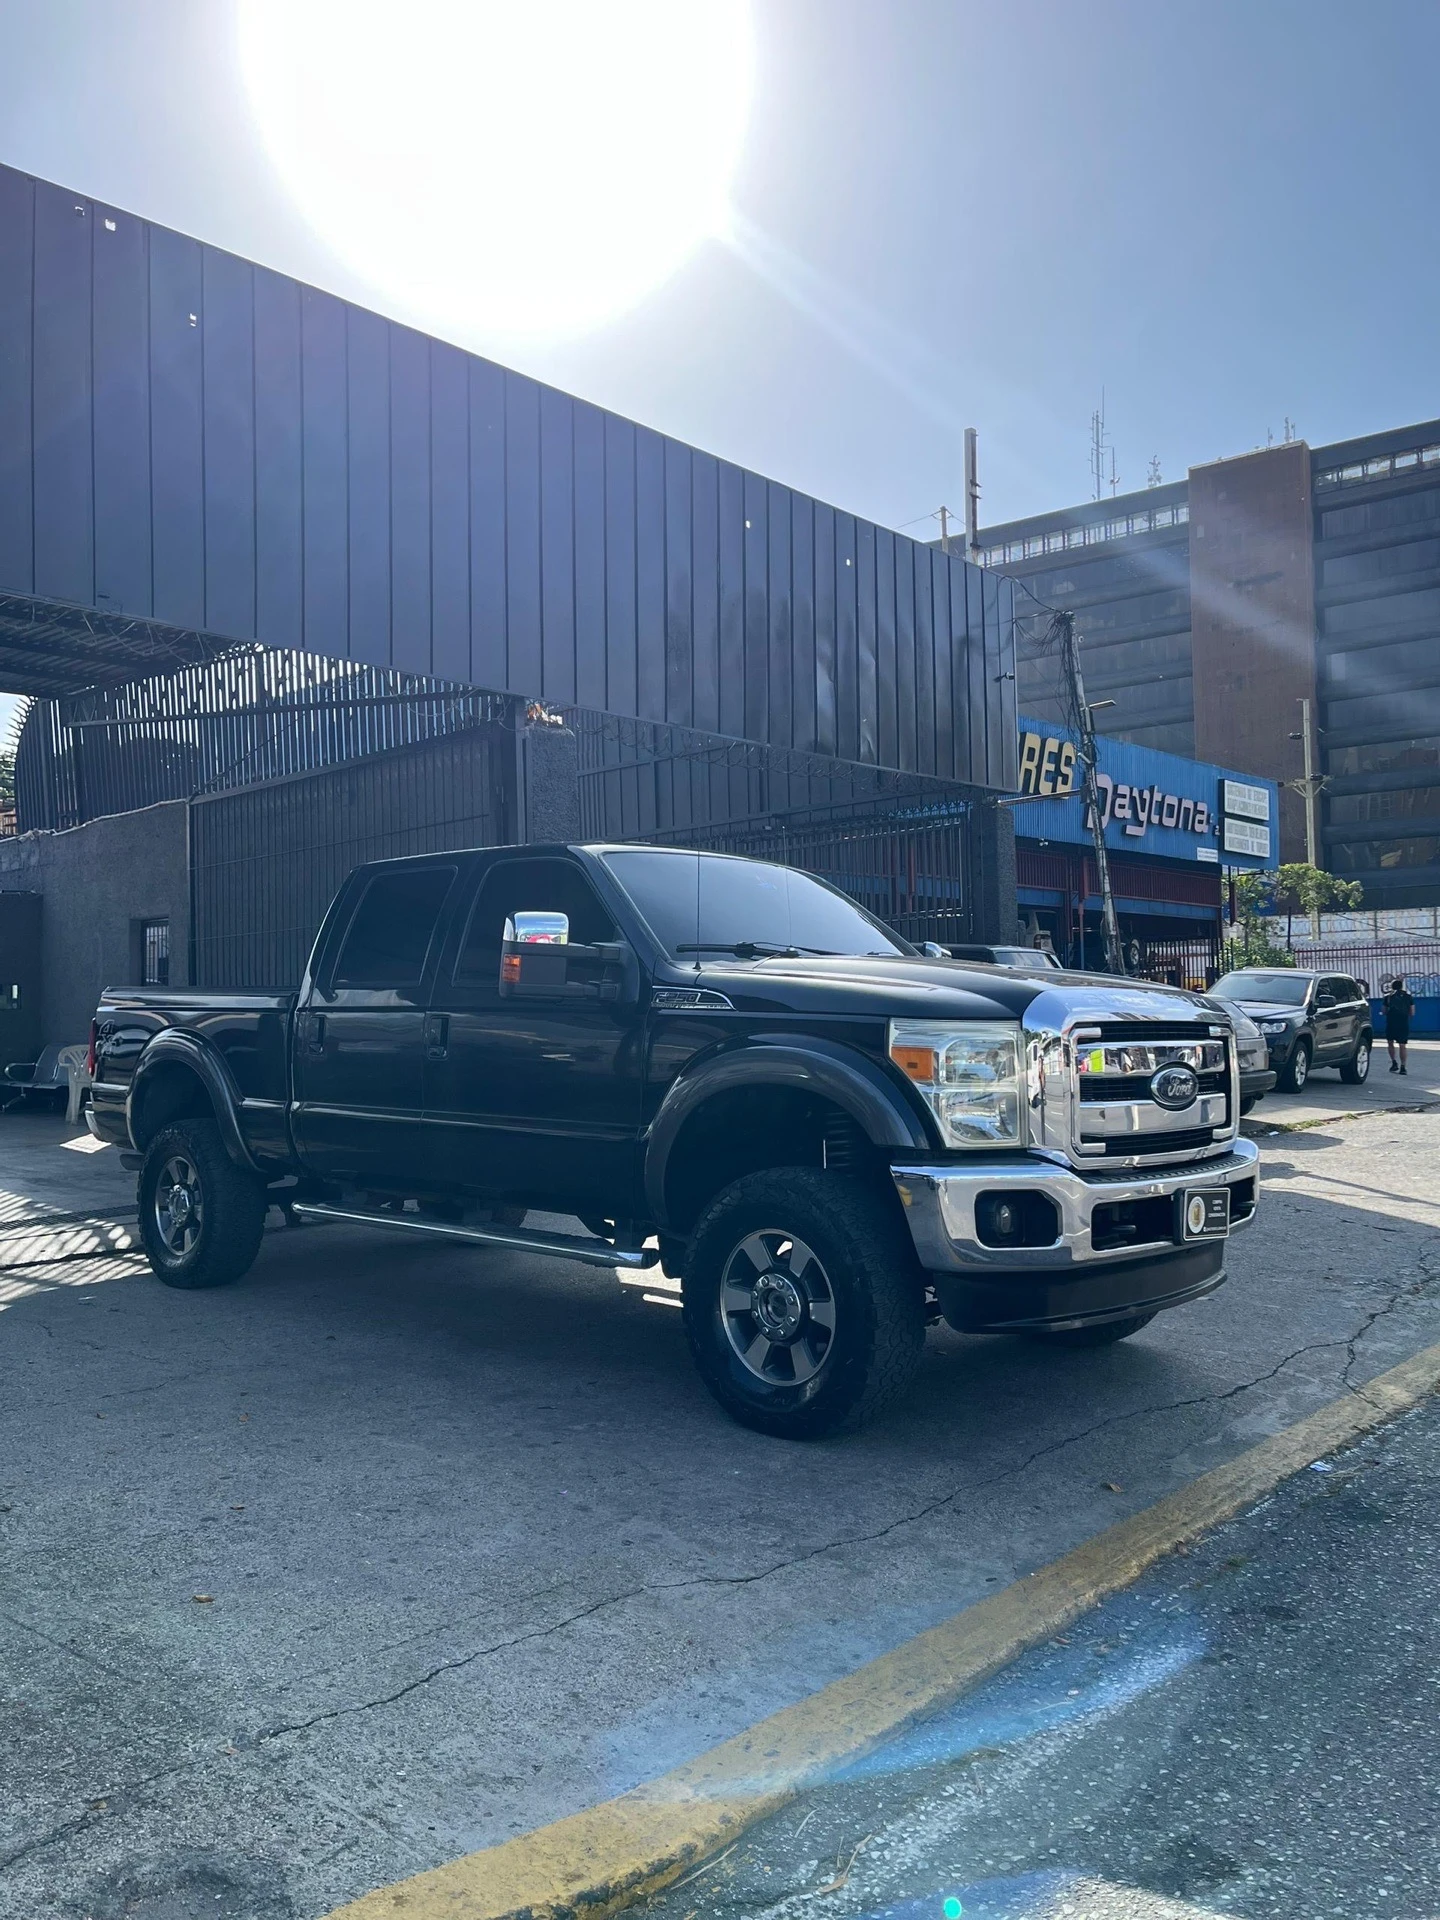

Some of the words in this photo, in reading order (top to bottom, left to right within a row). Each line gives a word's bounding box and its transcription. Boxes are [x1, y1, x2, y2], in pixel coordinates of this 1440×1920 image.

[1019, 731, 1076, 799] RES
[1086, 773, 1209, 837] Daytona
[1167, 1073, 1194, 1097] Ford
